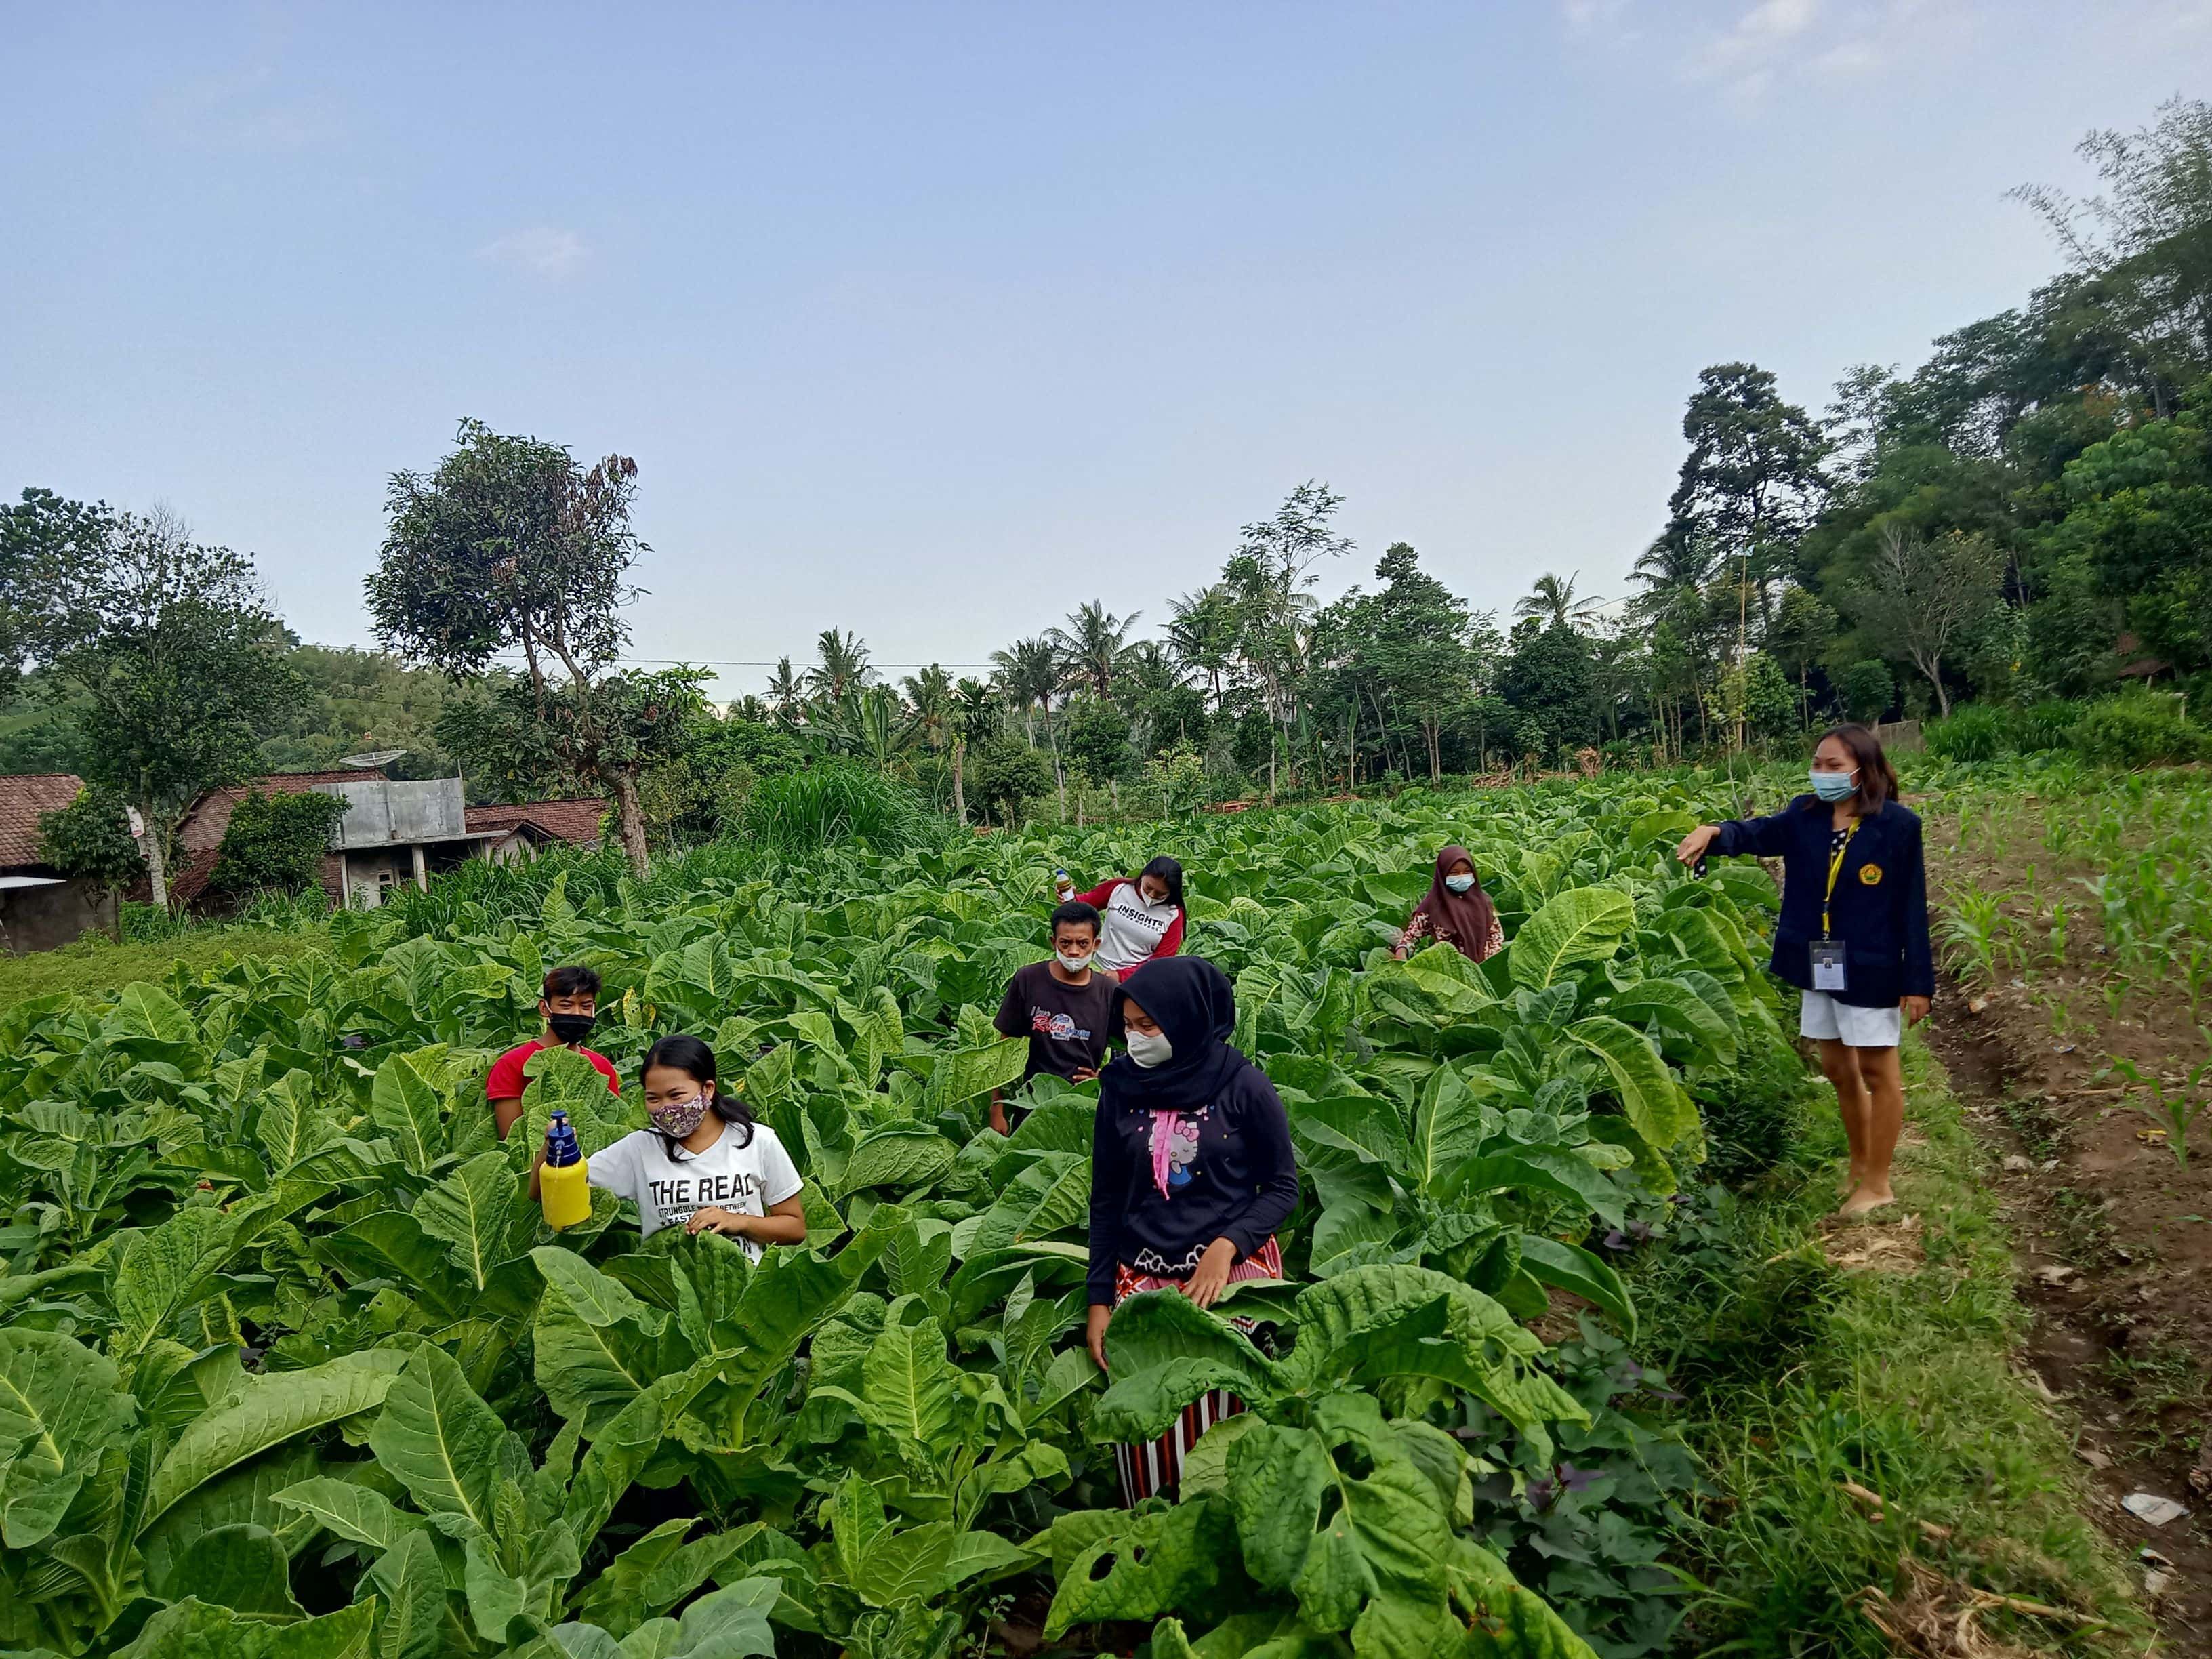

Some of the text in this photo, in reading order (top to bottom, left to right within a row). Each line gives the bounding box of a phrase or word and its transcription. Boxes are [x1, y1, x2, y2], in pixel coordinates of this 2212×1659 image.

[1118, 905, 1159, 926] INSIGHT
[649, 1179, 691, 1206] THE
[668, 1214, 692, 1225] EAST
